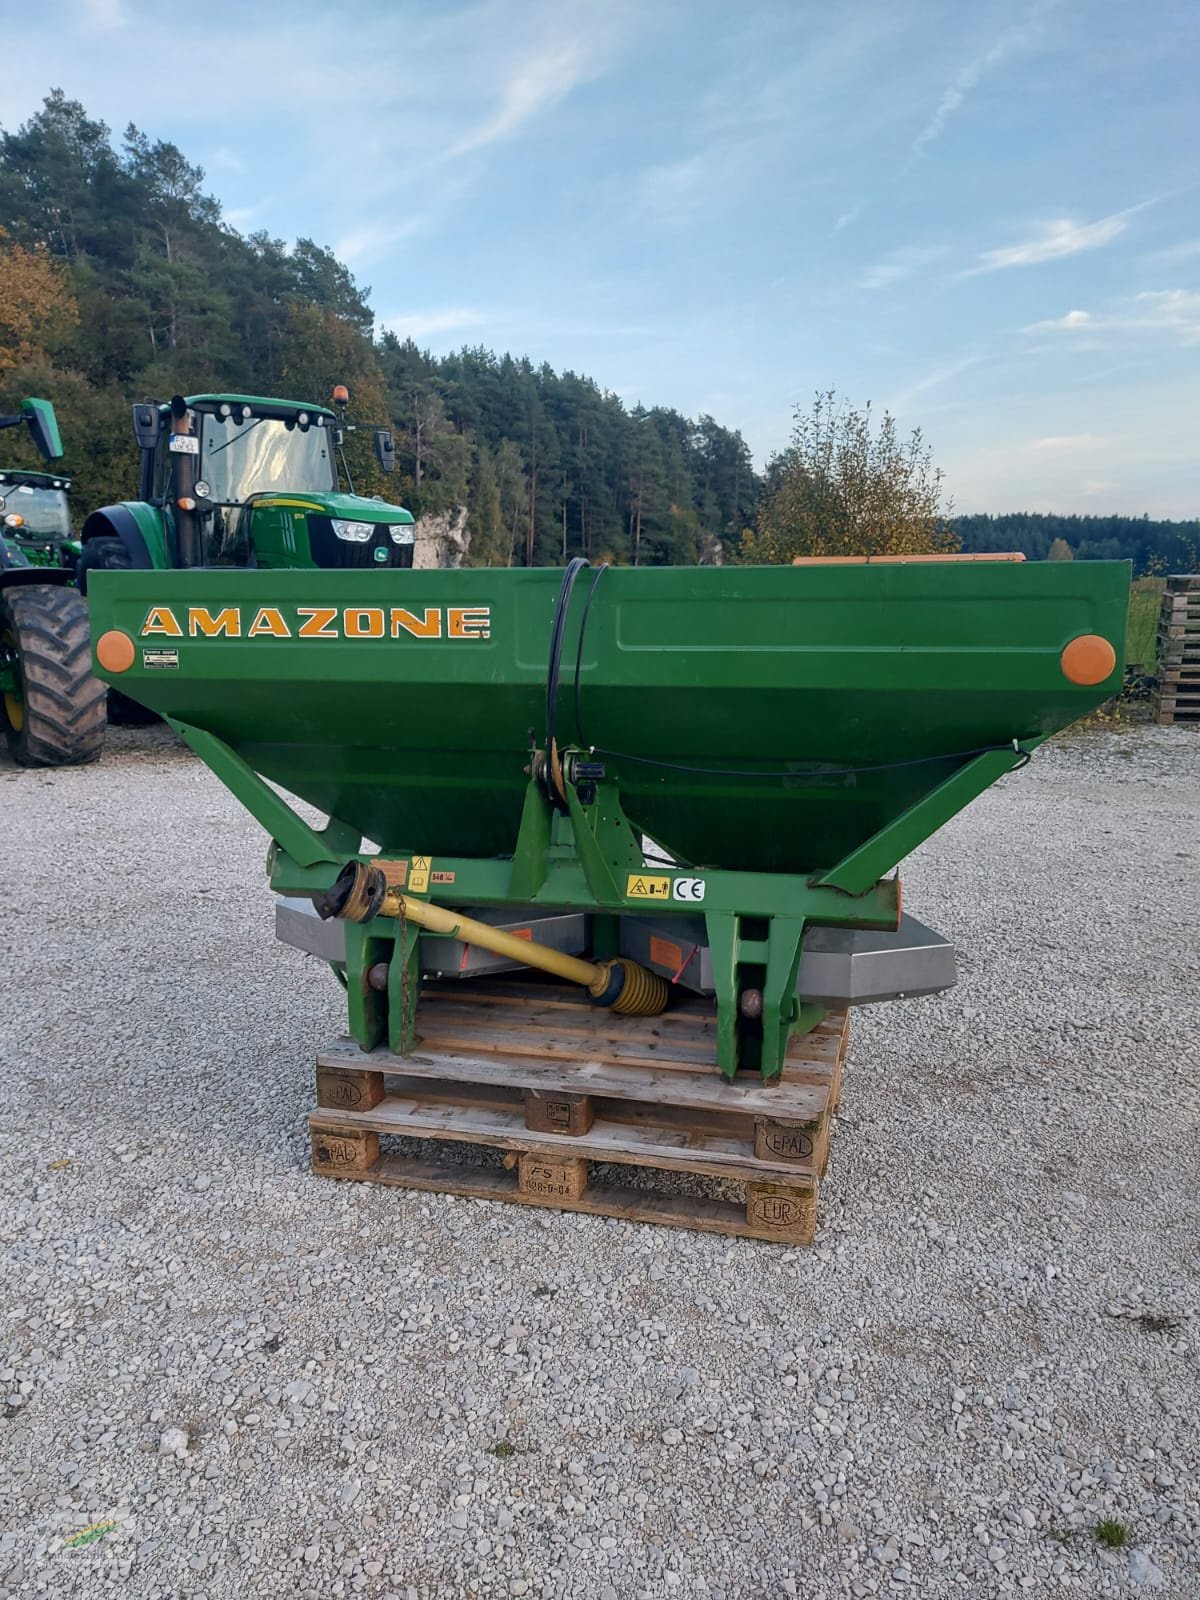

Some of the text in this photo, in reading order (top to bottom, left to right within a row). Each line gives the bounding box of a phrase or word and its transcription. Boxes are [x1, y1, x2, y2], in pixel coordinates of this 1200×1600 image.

[140, 606, 491, 639] AMAZONE
[676, 879, 704, 899] CE
[773, 1134, 806, 1154] EPAL
[763, 1200, 791, 1224] EUR
